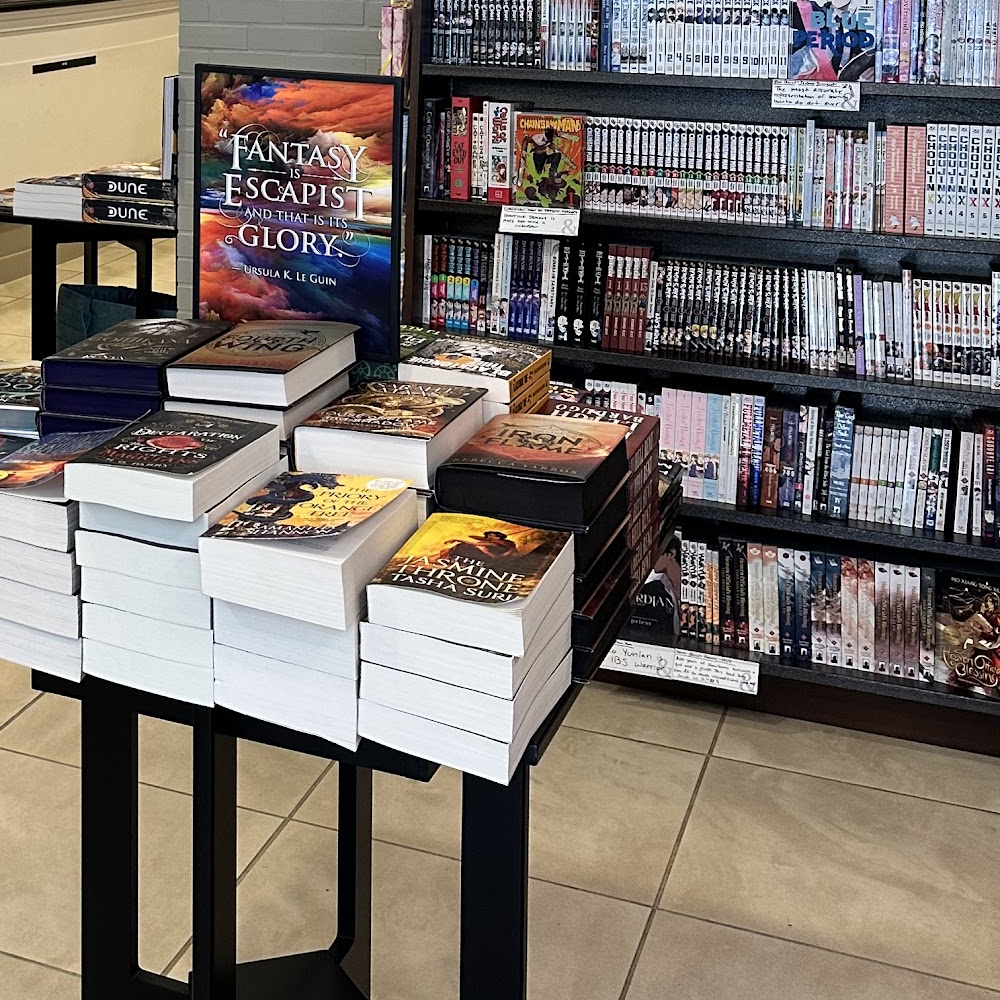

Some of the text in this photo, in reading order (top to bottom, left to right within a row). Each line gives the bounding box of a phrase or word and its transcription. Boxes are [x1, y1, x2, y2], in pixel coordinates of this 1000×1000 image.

[811, 8, 875, 30] BLUE
[793, 30, 875, 55] PERIOD
[520, 118, 580, 132] CHAINSAW MAN
[927, 134, 936, 192] CHOUJIN
[937, 134, 946, 204] CHOUJIN X
[948, 136, 957, 204] CHOUJIN X
[958, 136, 968, 192] CHOUJIN
[970, 138, 980, 194] CHOUJIN
[982, 138, 993, 194] CHOUJIN
[289, 168, 301, 180] IS
[107, 180, 148, 195] DUNE
[222, 172, 373, 222] ESCAPIST
[928, 194, 934, 204] X
[107, 206, 148, 220] DUNE
[244, 207, 348, 229] AND THAT IS ITS
[244, 264, 337, 286] URSULA K. LE GUIN
[211, 340, 305, 353] WING
[216, 334, 317, 346] FOURTH
[555, 404, 644, 424] BARDUGO
[131, 426, 246, 443] DECLARATION
[741, 404, 752, 446] FULLMETAL
[752, 405, 763, 446] FULLMETAL
[484, 438, 582, 455] FLAME
[498, 428, 586, 446] IRON
[695, 428, 703, 449] Basket
[710, 430, 719, 451] Basket
[116, 442, 209, 460] RIGHTS
[453, 456, 578, 474] REBECCA YARROS
[318, 491, 386, 500] PRIORY
[299, 502, 376, 512] ORANGE
[402, 554, 525, 584] JASMINE
[454, 555, 484, 567] THE
[391, 573, 516, 602] TASHA SURI
[398, 564, 522, 594] THRONE
[636, 594, 674, 608] RDIAN
[630, 618, 652, 626] priest
[955, 662, 998, 688] Blessing
